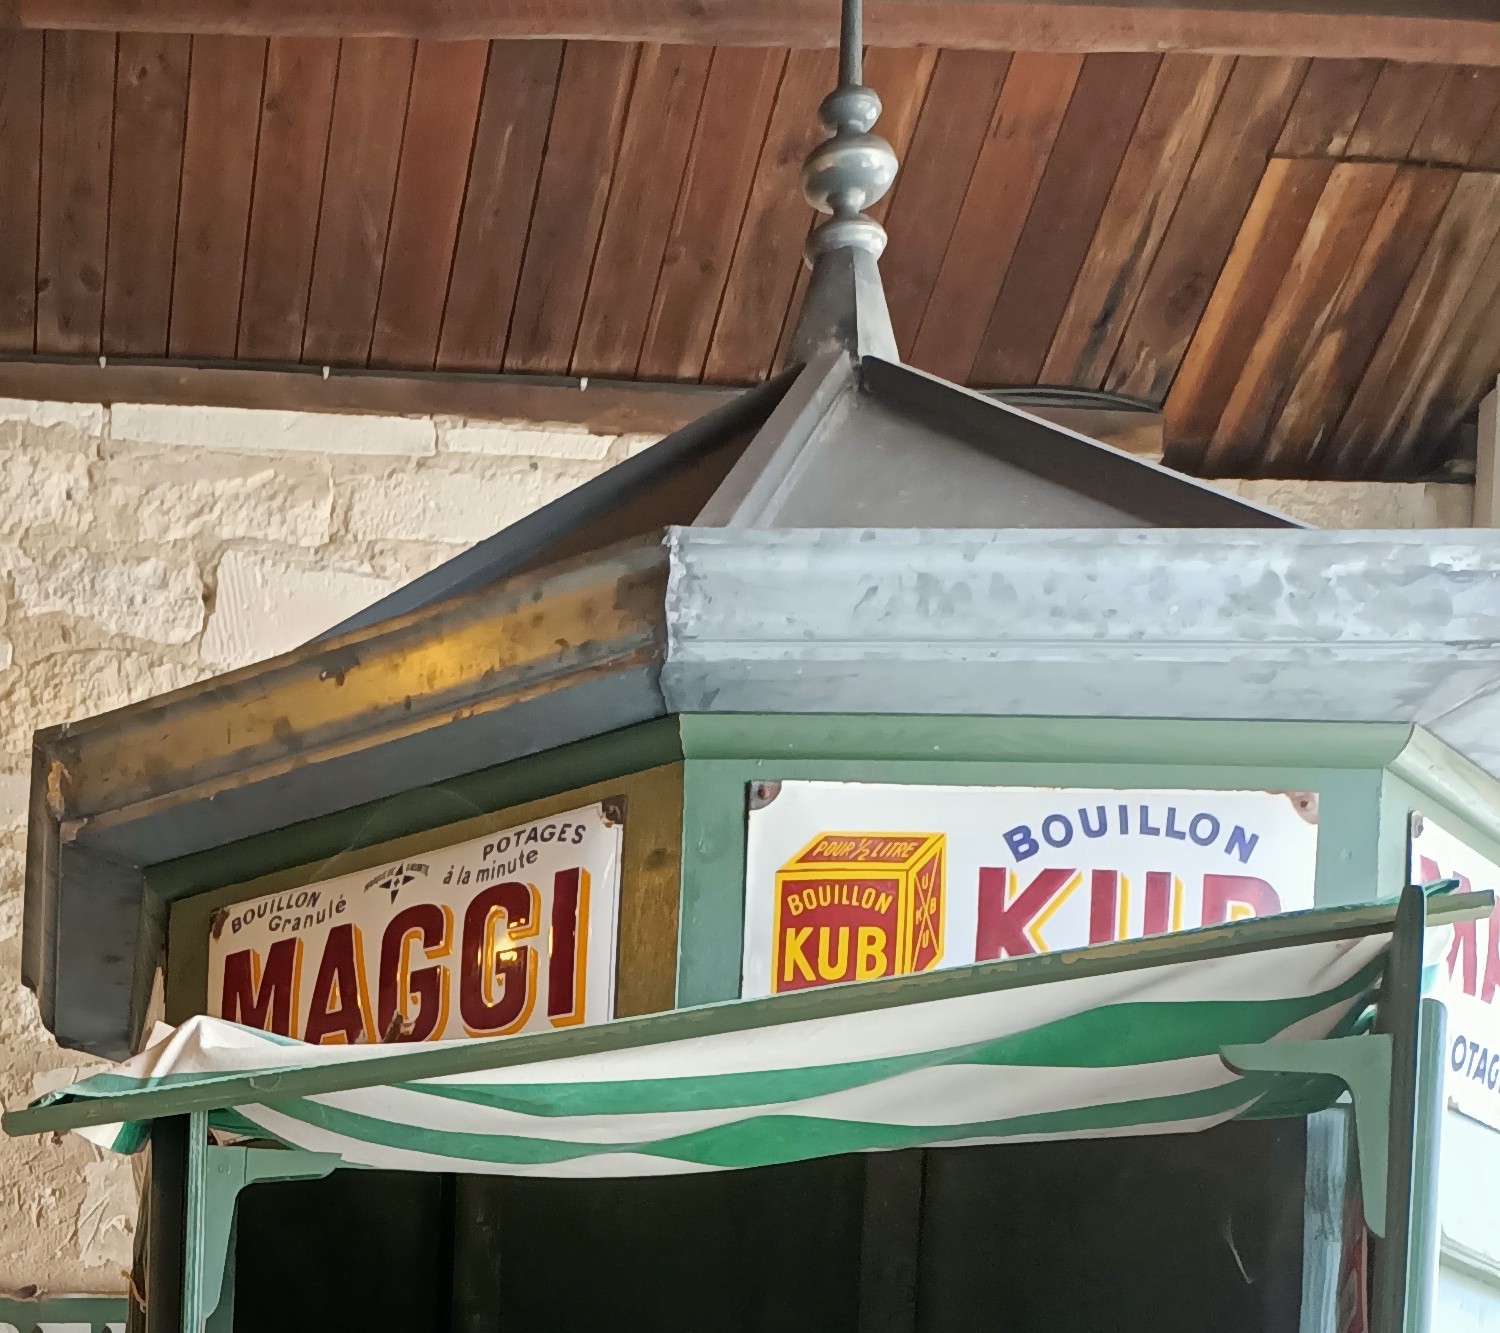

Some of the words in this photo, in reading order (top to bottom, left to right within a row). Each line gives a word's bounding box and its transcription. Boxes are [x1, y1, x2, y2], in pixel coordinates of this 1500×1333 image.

[483, 823, 587, 861] POTAGES
[813, 841, 853, 860] POUR
[873, 840, 917, 860] LITRE
[1003, 804, 1260, 864] BOUILLON
[457, 865, 471, 885] la
[476, 849, 539, 883] minute
[231, 891, 321, 934] BOUILLON
[269, 894, 346, 933] Granulé
[787, 885, 893, 917] BOUILLON
[221, 867, 591, 1045] MAGGI
[784, 926, 888, 982] KUB
